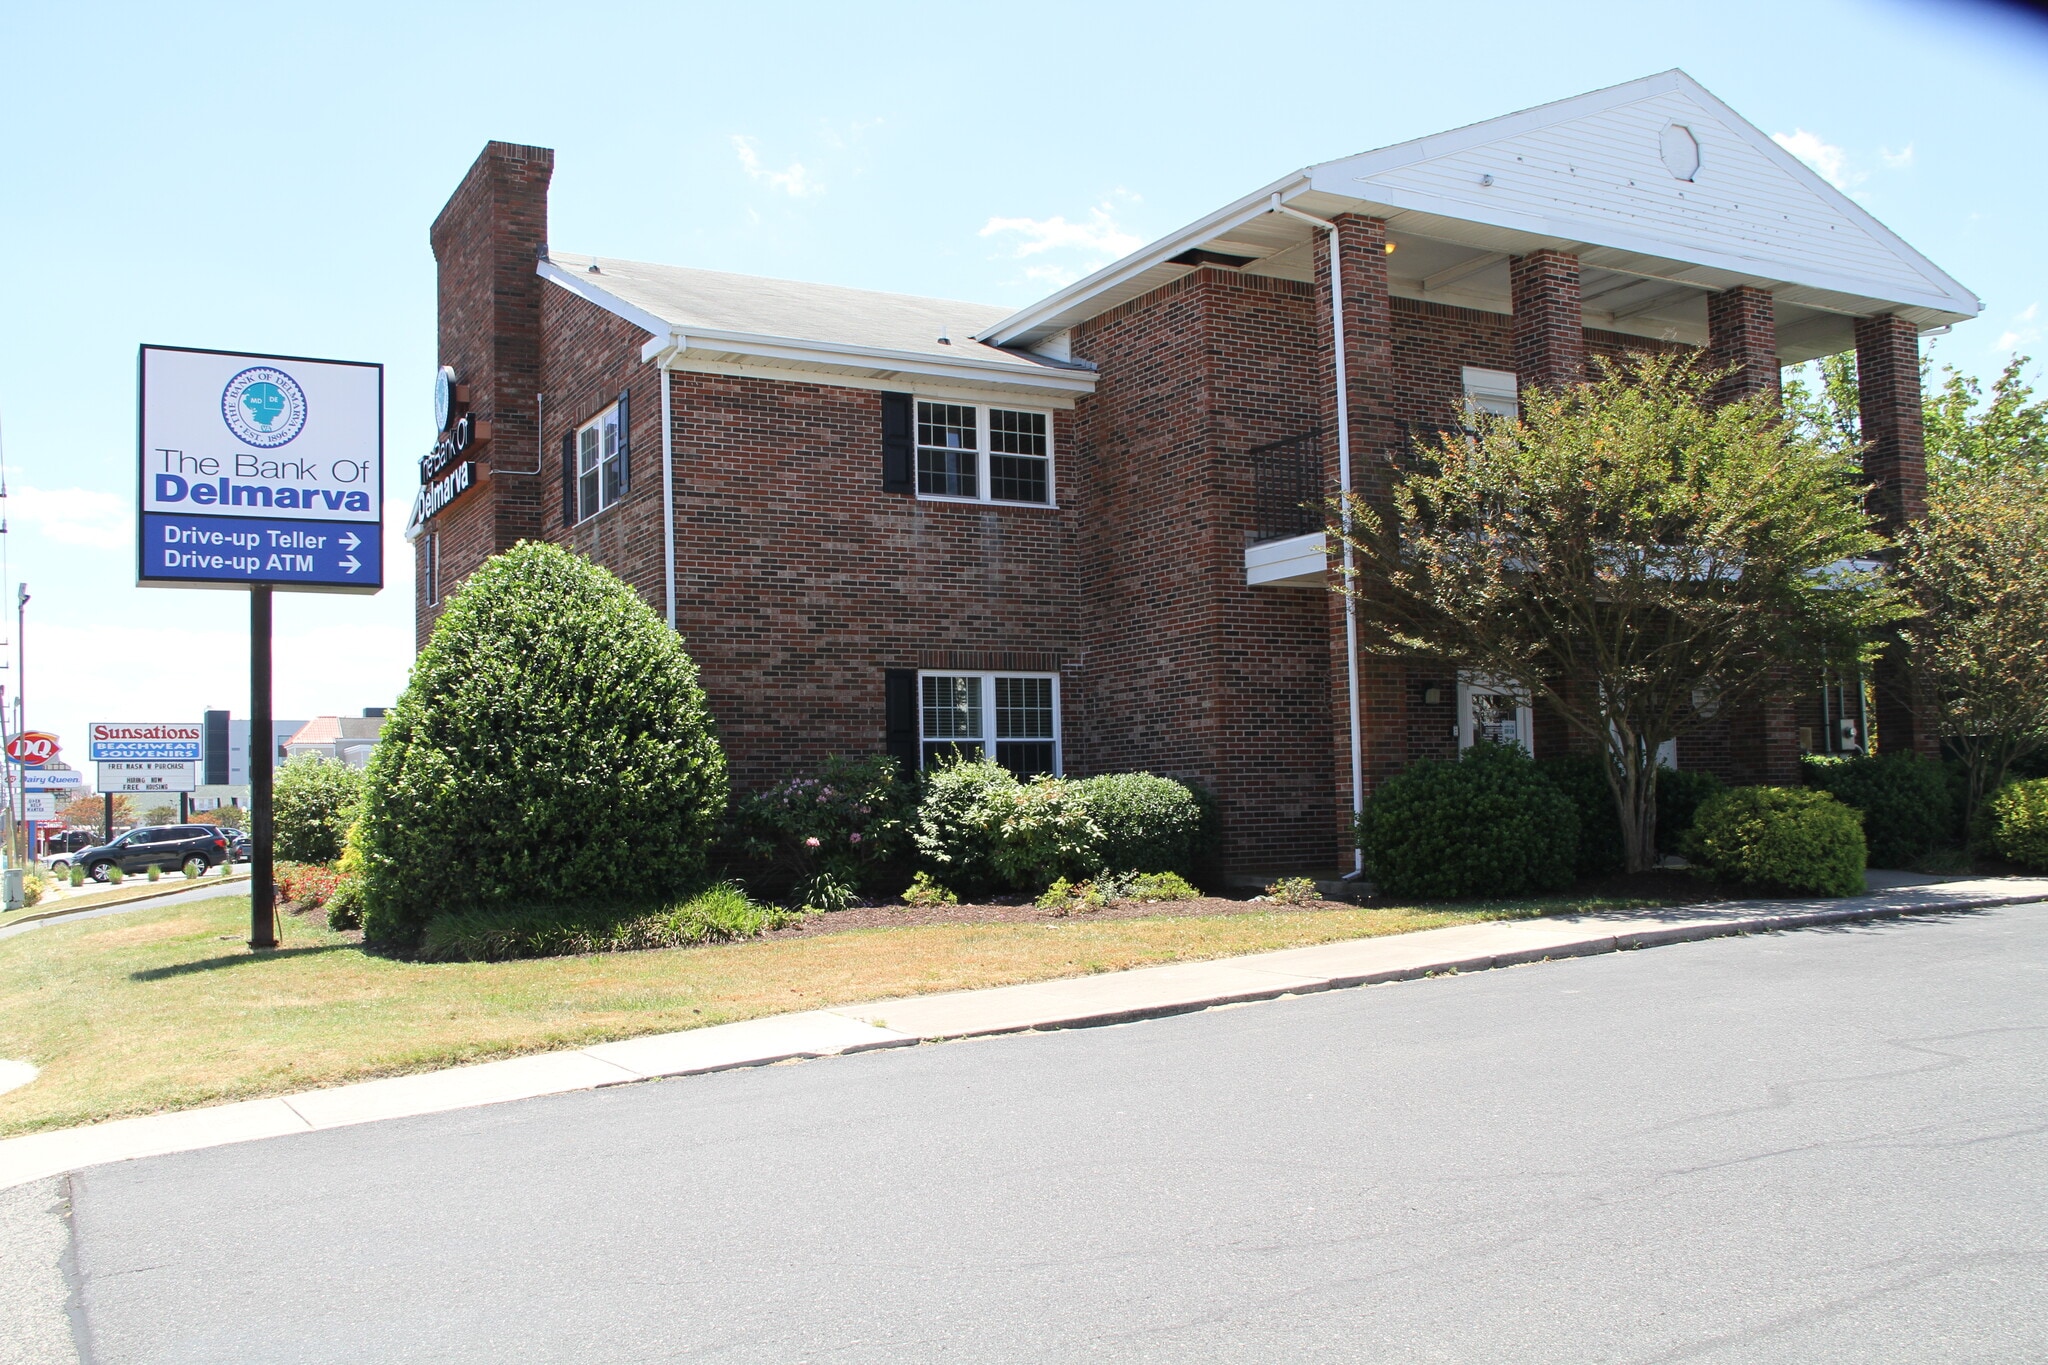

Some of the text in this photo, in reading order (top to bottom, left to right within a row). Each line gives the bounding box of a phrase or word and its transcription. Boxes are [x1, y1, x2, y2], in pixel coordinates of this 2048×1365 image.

[229, 373, 301, 427] THE BANK OF DELMARVA
[268, 431, 288, 442] 1896
[155, 448, 370, 484] The Bank Of
[155, 473, 371, 512] Delmarva
[418, 461, 469, 524] Delmarva
[164, 525, 327, 550] Drive-up Teller
[164, 550, 314, 574] Drive-up ATM
[93, 725, 200, 740] Sunsations
[14, 739, 52, 759] DQ
[47, 775, 79, 784] Queen
